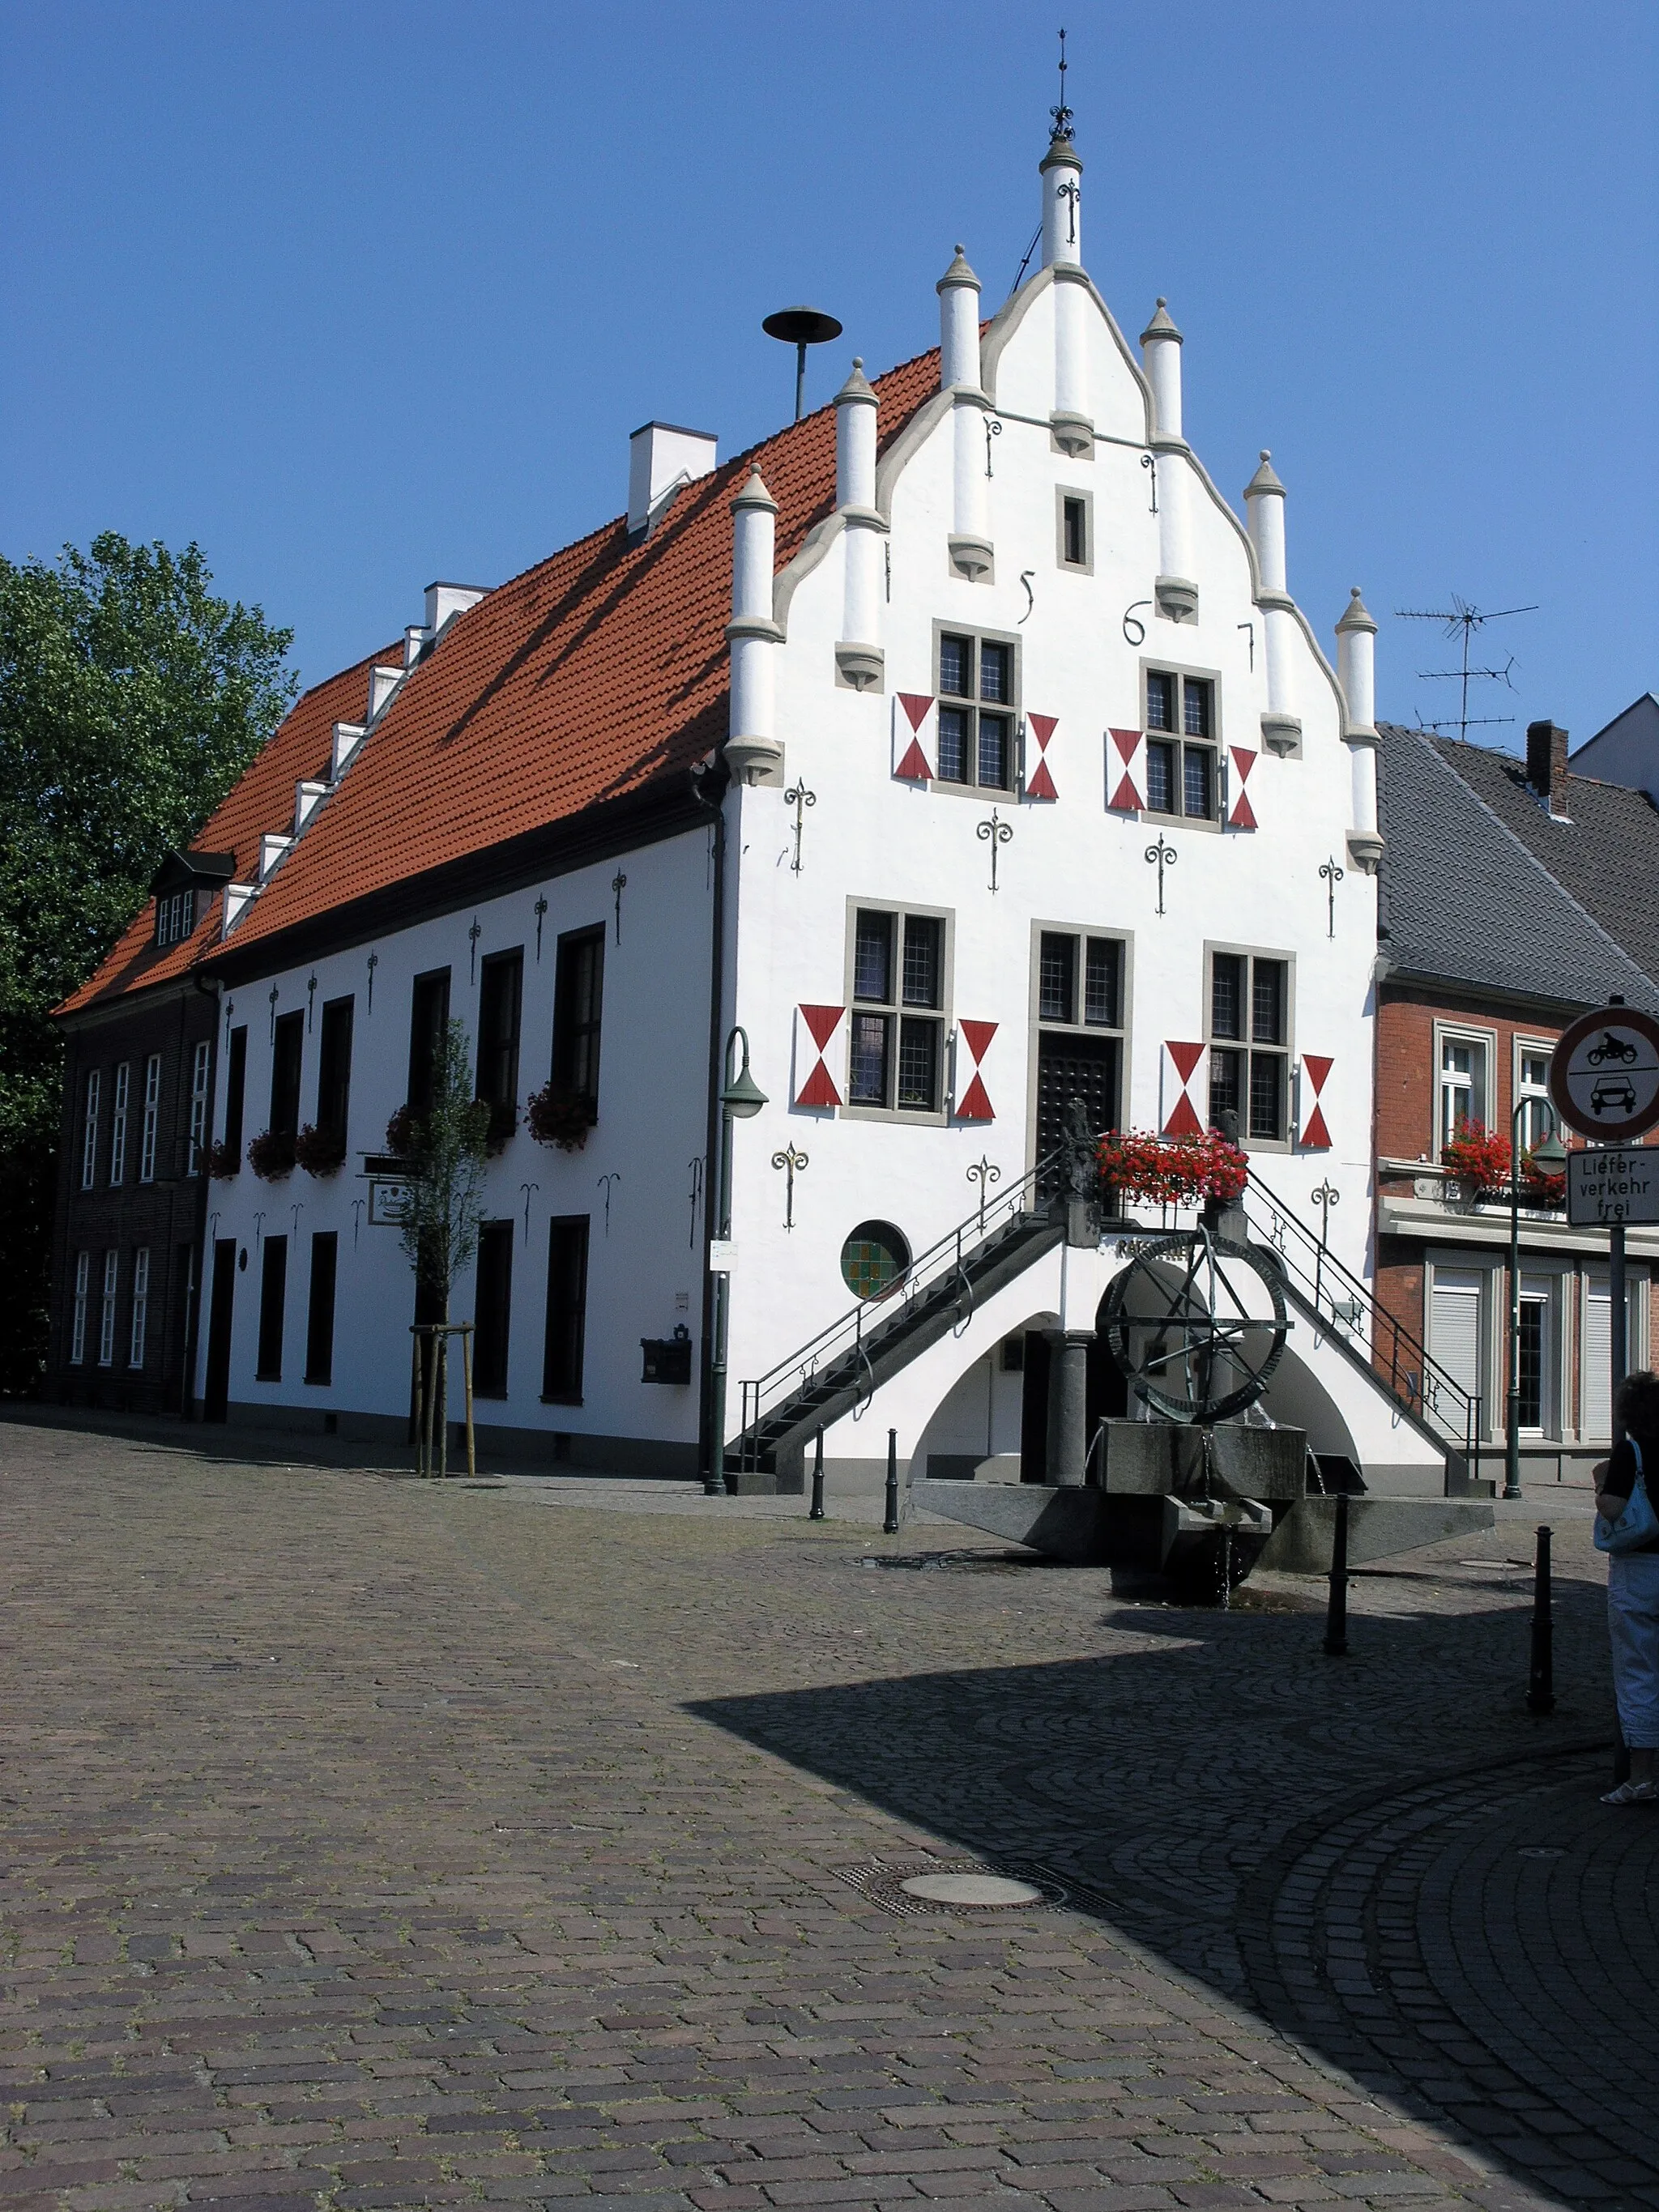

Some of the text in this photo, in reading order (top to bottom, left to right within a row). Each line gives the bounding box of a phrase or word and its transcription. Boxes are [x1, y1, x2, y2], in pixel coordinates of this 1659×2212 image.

[1583, 1157, 1645, 1175] Liefer-
[1580, 1177, 1650, 1197] verkehr
[1597, 1199, 1630, 1217] frei
